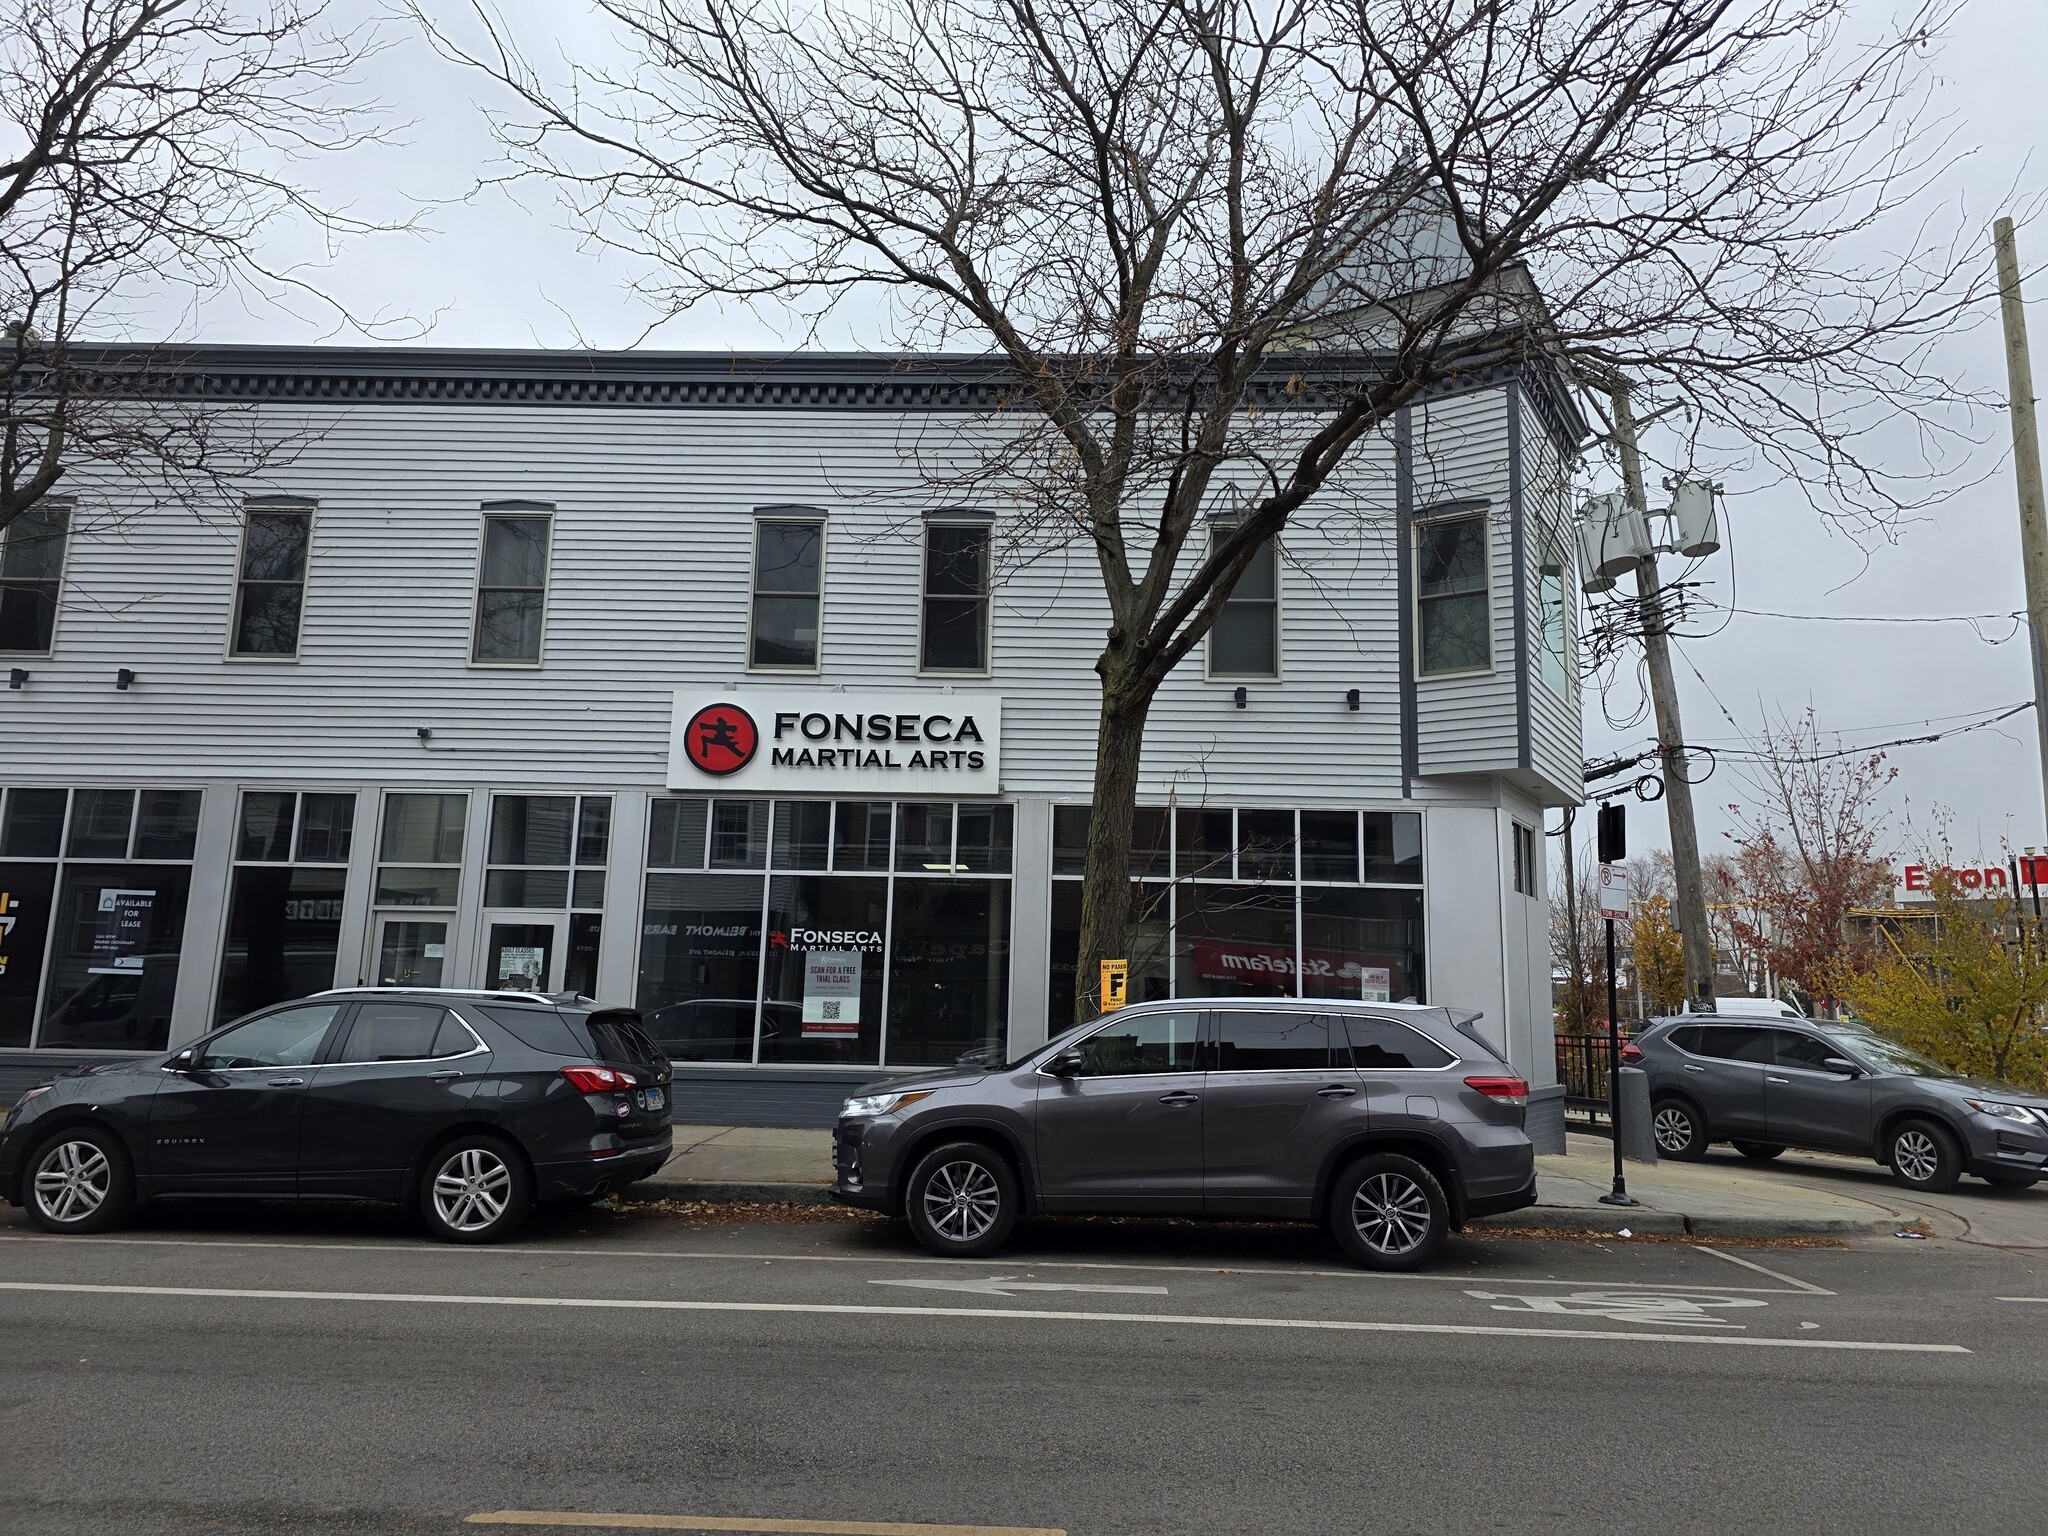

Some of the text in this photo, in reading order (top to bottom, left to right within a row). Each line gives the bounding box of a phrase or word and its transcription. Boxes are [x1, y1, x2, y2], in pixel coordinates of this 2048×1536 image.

[774, 712, 984, 742] FONSECA
[771, 748, 985, 769] MARTIAL ARTS
[790, 928, 883, 944] FONSECA
[790, 944, 883, 953] MARTIAL ARTS
[811, 966, 825, 974] SCAN
[826, 966, 837, 974] FOR
[843, 967, 857, 975] FREE
[816, 975, 850, 984] TRIAL CLASS
[1110, 973, 1124, 997] F
